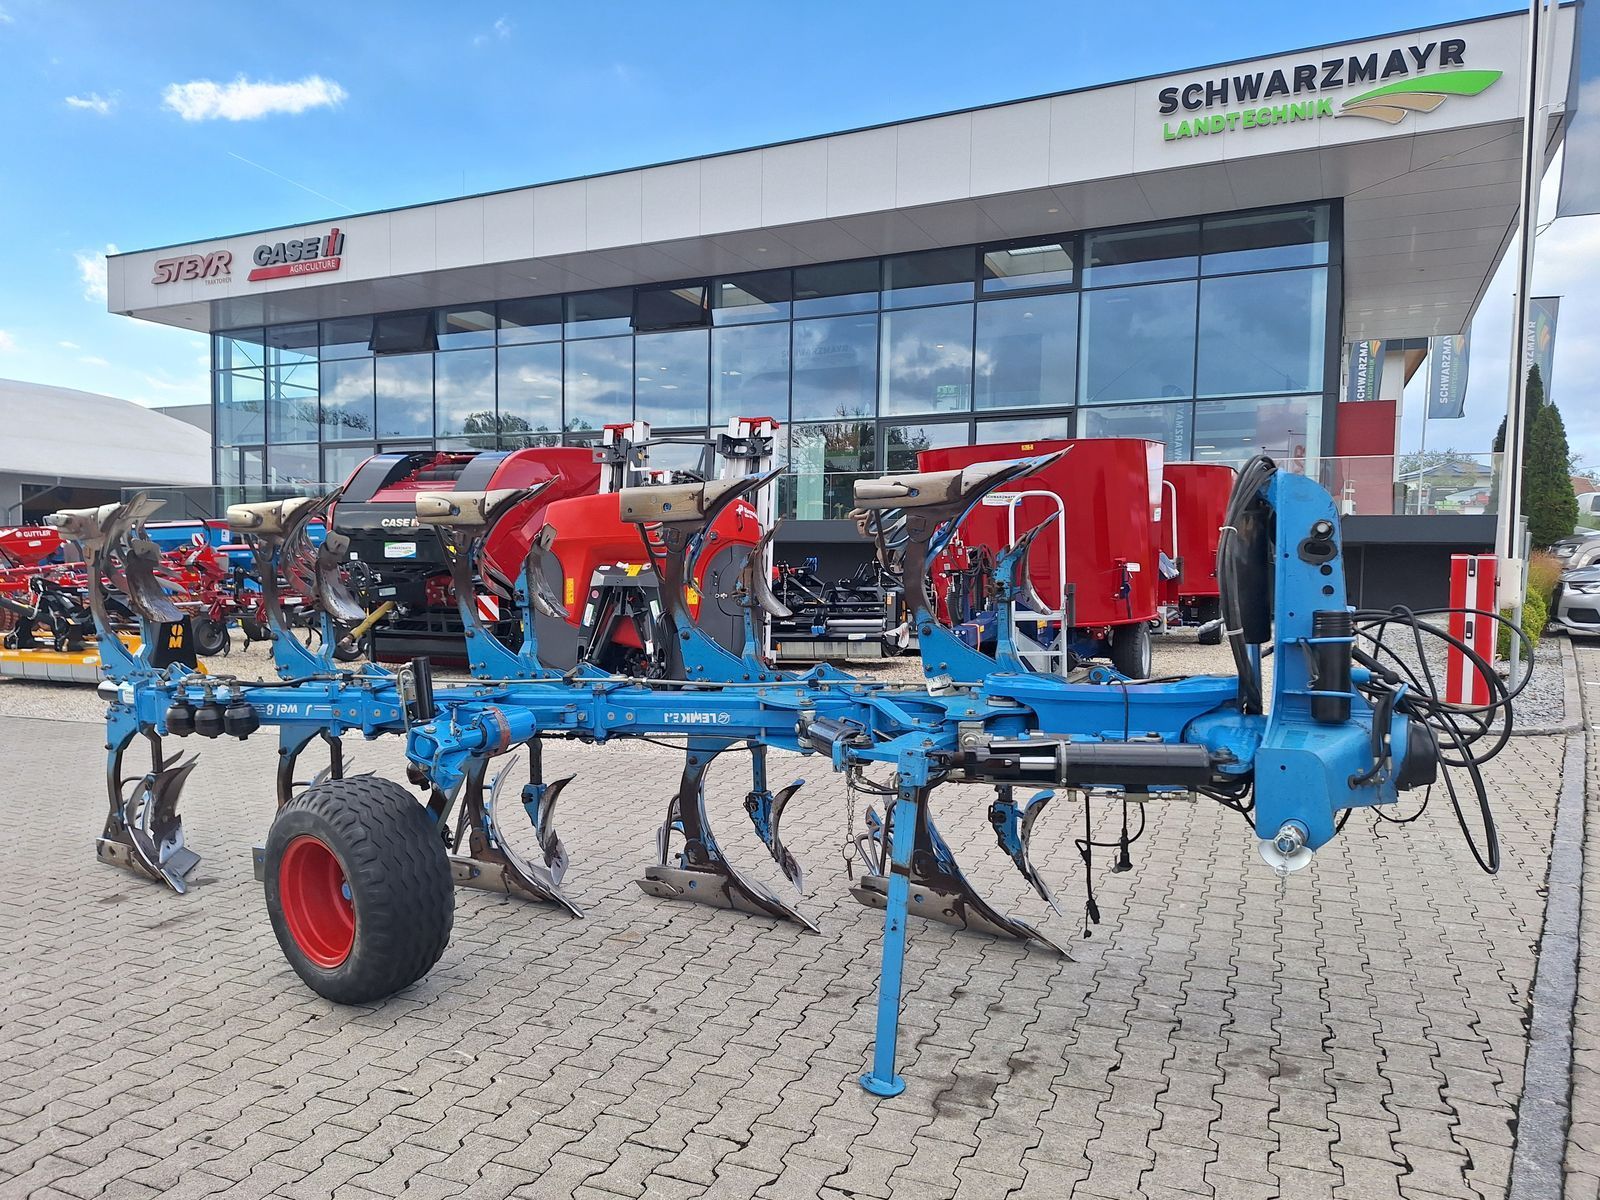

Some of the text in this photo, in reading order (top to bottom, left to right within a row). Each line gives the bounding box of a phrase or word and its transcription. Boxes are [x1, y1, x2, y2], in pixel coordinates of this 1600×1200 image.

[1158, 38, 1467, 116] SCHWARZMAYR
[1163, 97, 1335, 141] LANDTECHNIK
[151, 250, 233, 285] STEYR
[289, 258, 337, 274] AGRICULTURE
[1356, 341, 1369, 401] CHWARZMA
[1367, 358, 1376, 400] ANDTECHNIK
[1440, 336, 1452, 404] SCHWARZMAY
[381, 518, 410, 528] CASE
